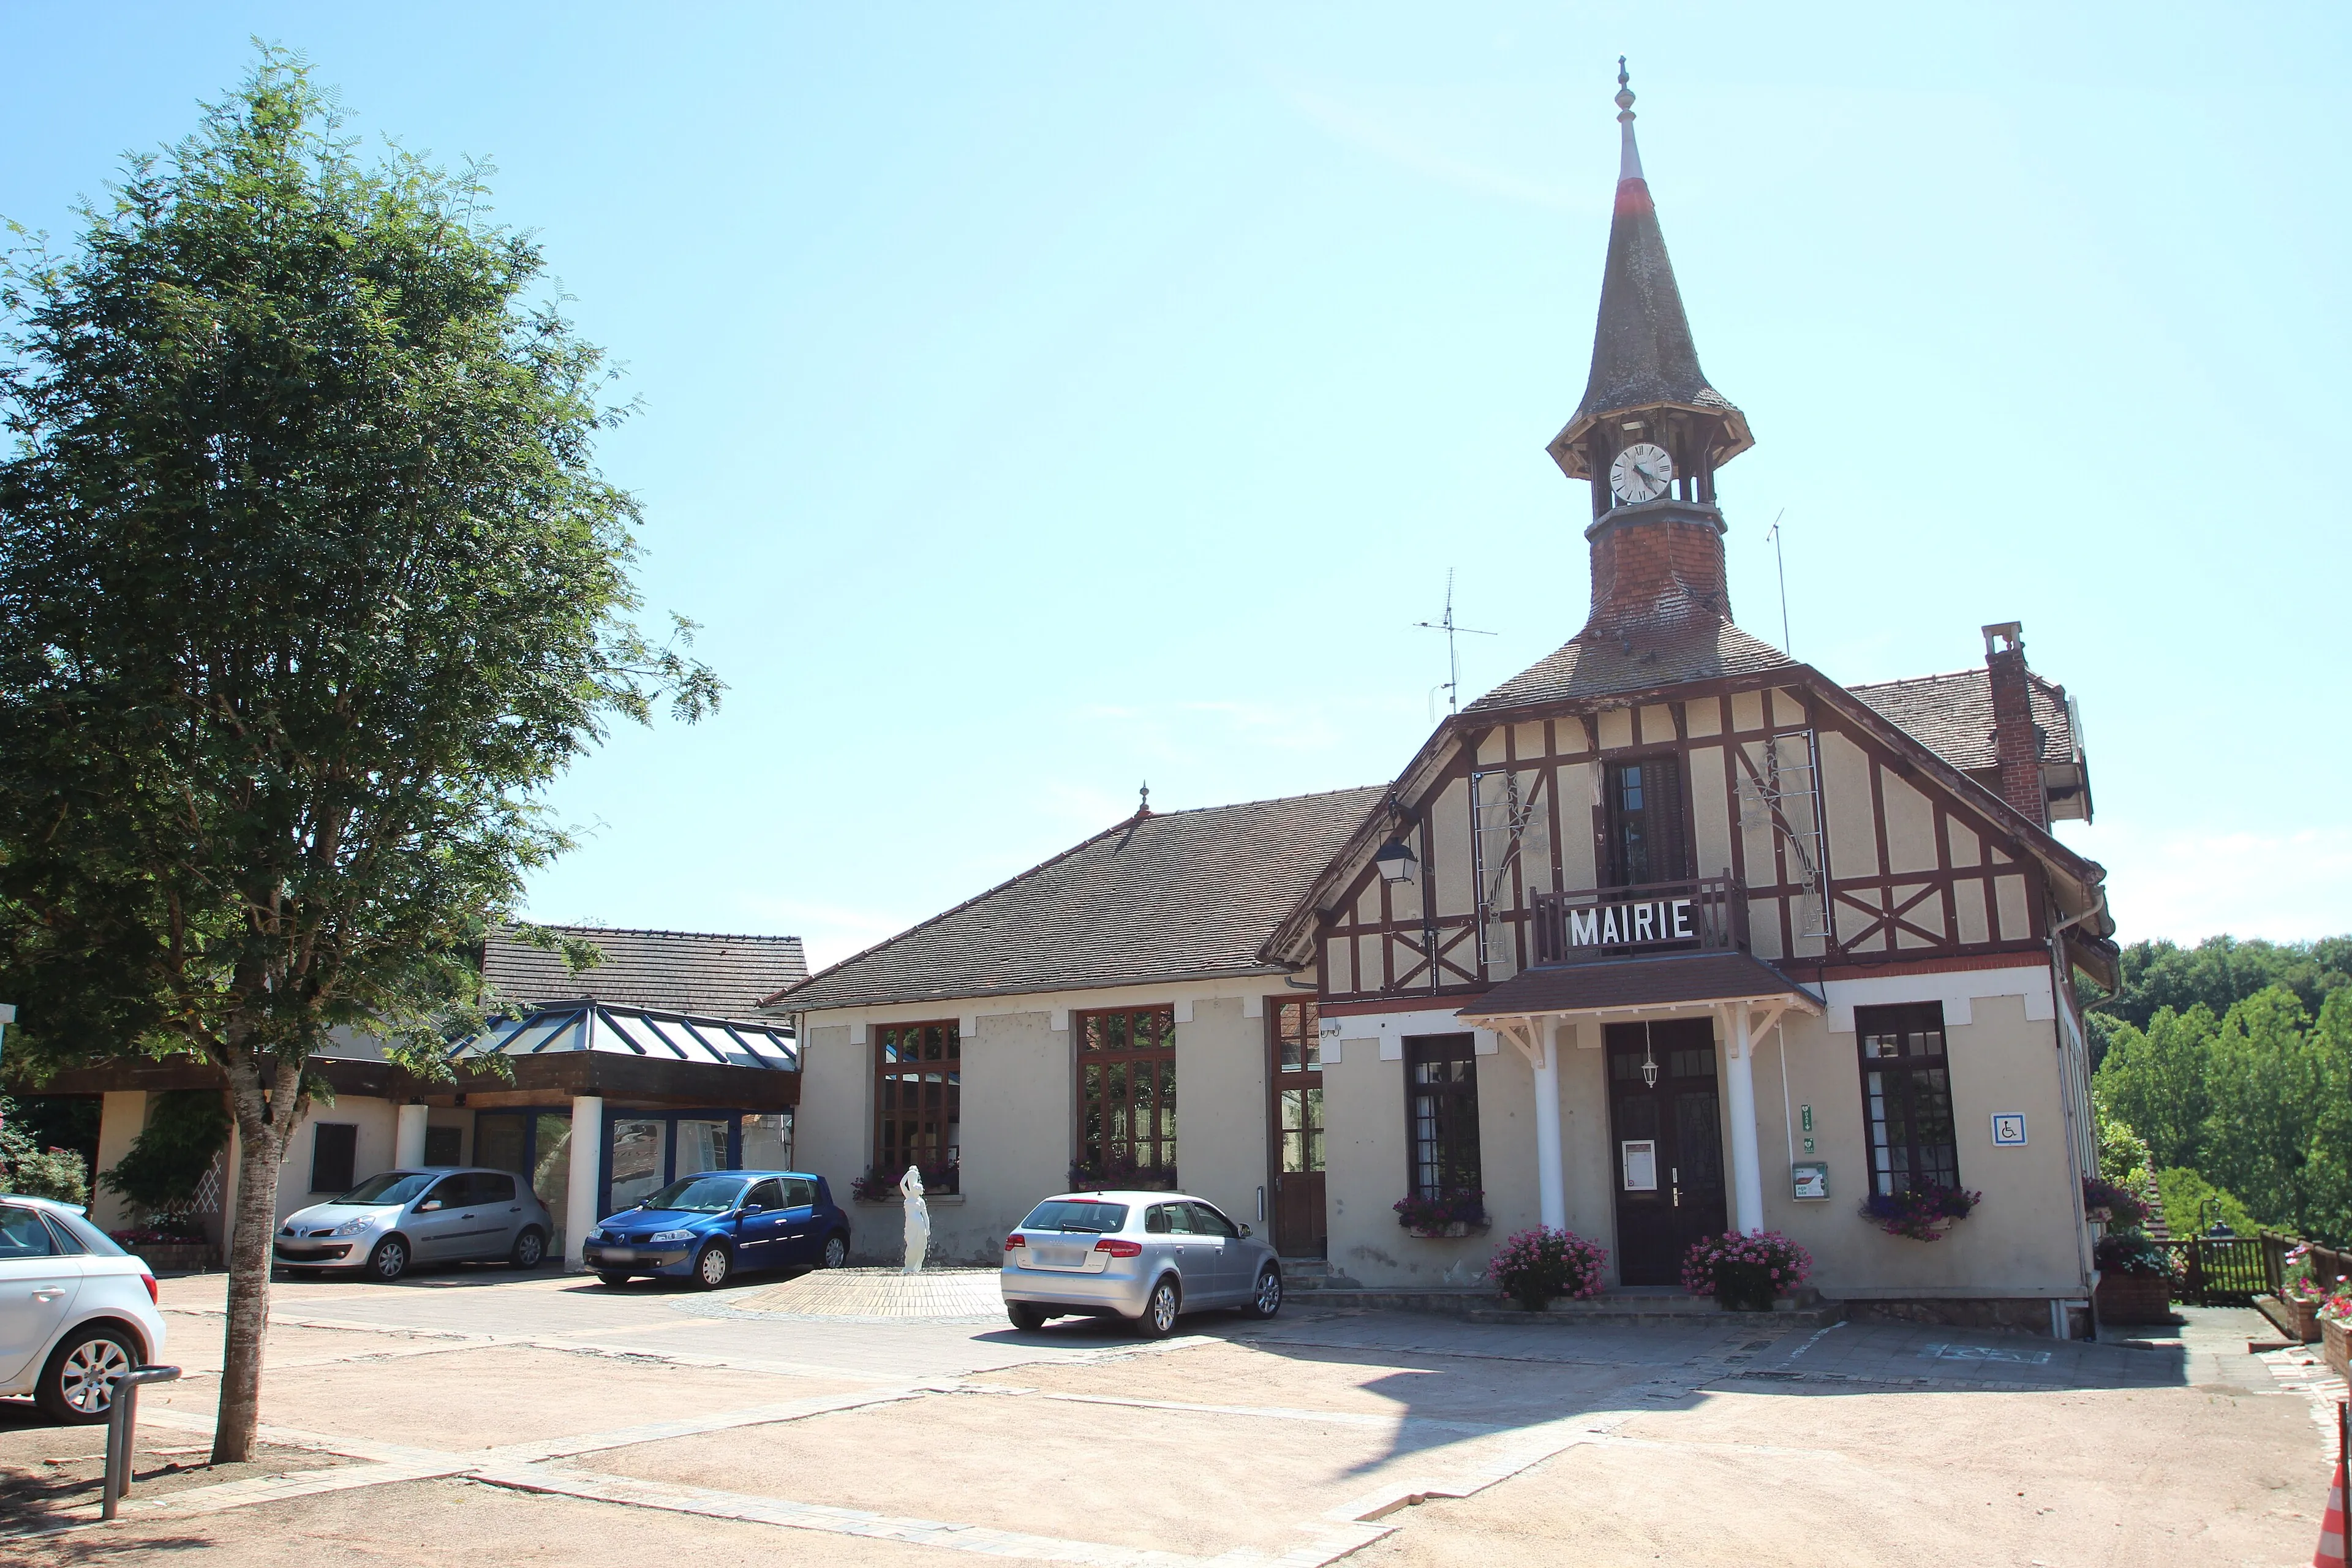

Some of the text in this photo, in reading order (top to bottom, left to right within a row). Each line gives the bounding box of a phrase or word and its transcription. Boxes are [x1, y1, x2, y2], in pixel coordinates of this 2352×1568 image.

[1635, 445, 1643, 456] XII
[1611, 473, 1622, 482] IX
[1638, 491, 1646, 501] VI
[1570, 899, 1693, 946] MAIRIE
